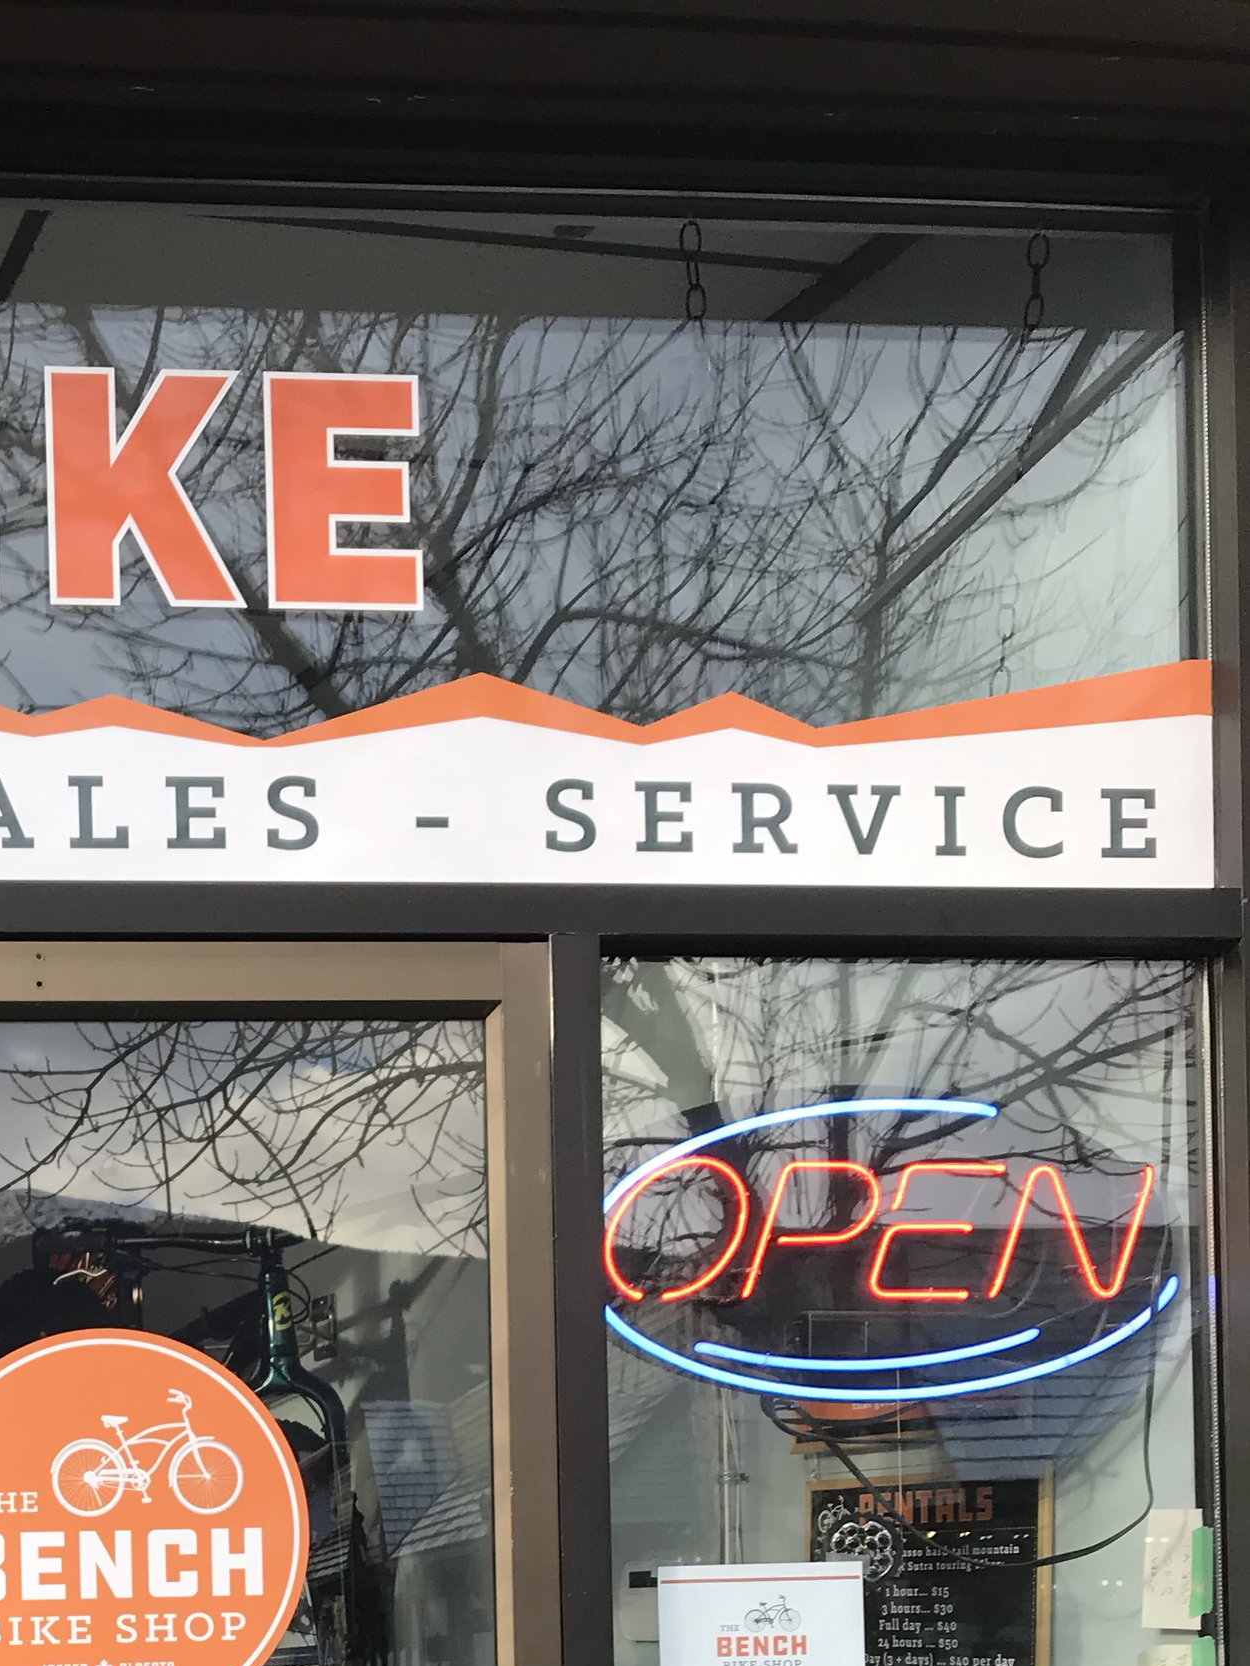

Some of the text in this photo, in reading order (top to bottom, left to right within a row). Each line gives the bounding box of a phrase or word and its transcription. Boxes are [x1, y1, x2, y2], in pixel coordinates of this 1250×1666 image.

[545, 779, 1157, 859] SERVICE
[604, 1155, 1156, 1302] OPEN
[859, 1486, 994, 1525] RENTALS
[972, 1544, 1020, 1556] mountain
[907, 1561, 933, 1571] Sutra
[936, 1560, 972, 1573] touring
[885, 1587, 890, 1597] 1
[931, 1586, 950, 1598] $15
[881, 1604, 888, 1615] 3
[933, 1604, 953, 1616] $30
[116, 1612, 246, 1644] SHOP
[720, 1624, 740, 1632] THE
[878, 1619, 899, 1631] Full
[902, 1619, 922, 1634] day
[937, 1621, 957, 1633] $40
[716, 1635, 808, 1657] BENCH
[878, 1638, 889, 1650] 24
[892, 1637, 923, 1649] hours
[938, 1639, 958, 1650] $50
